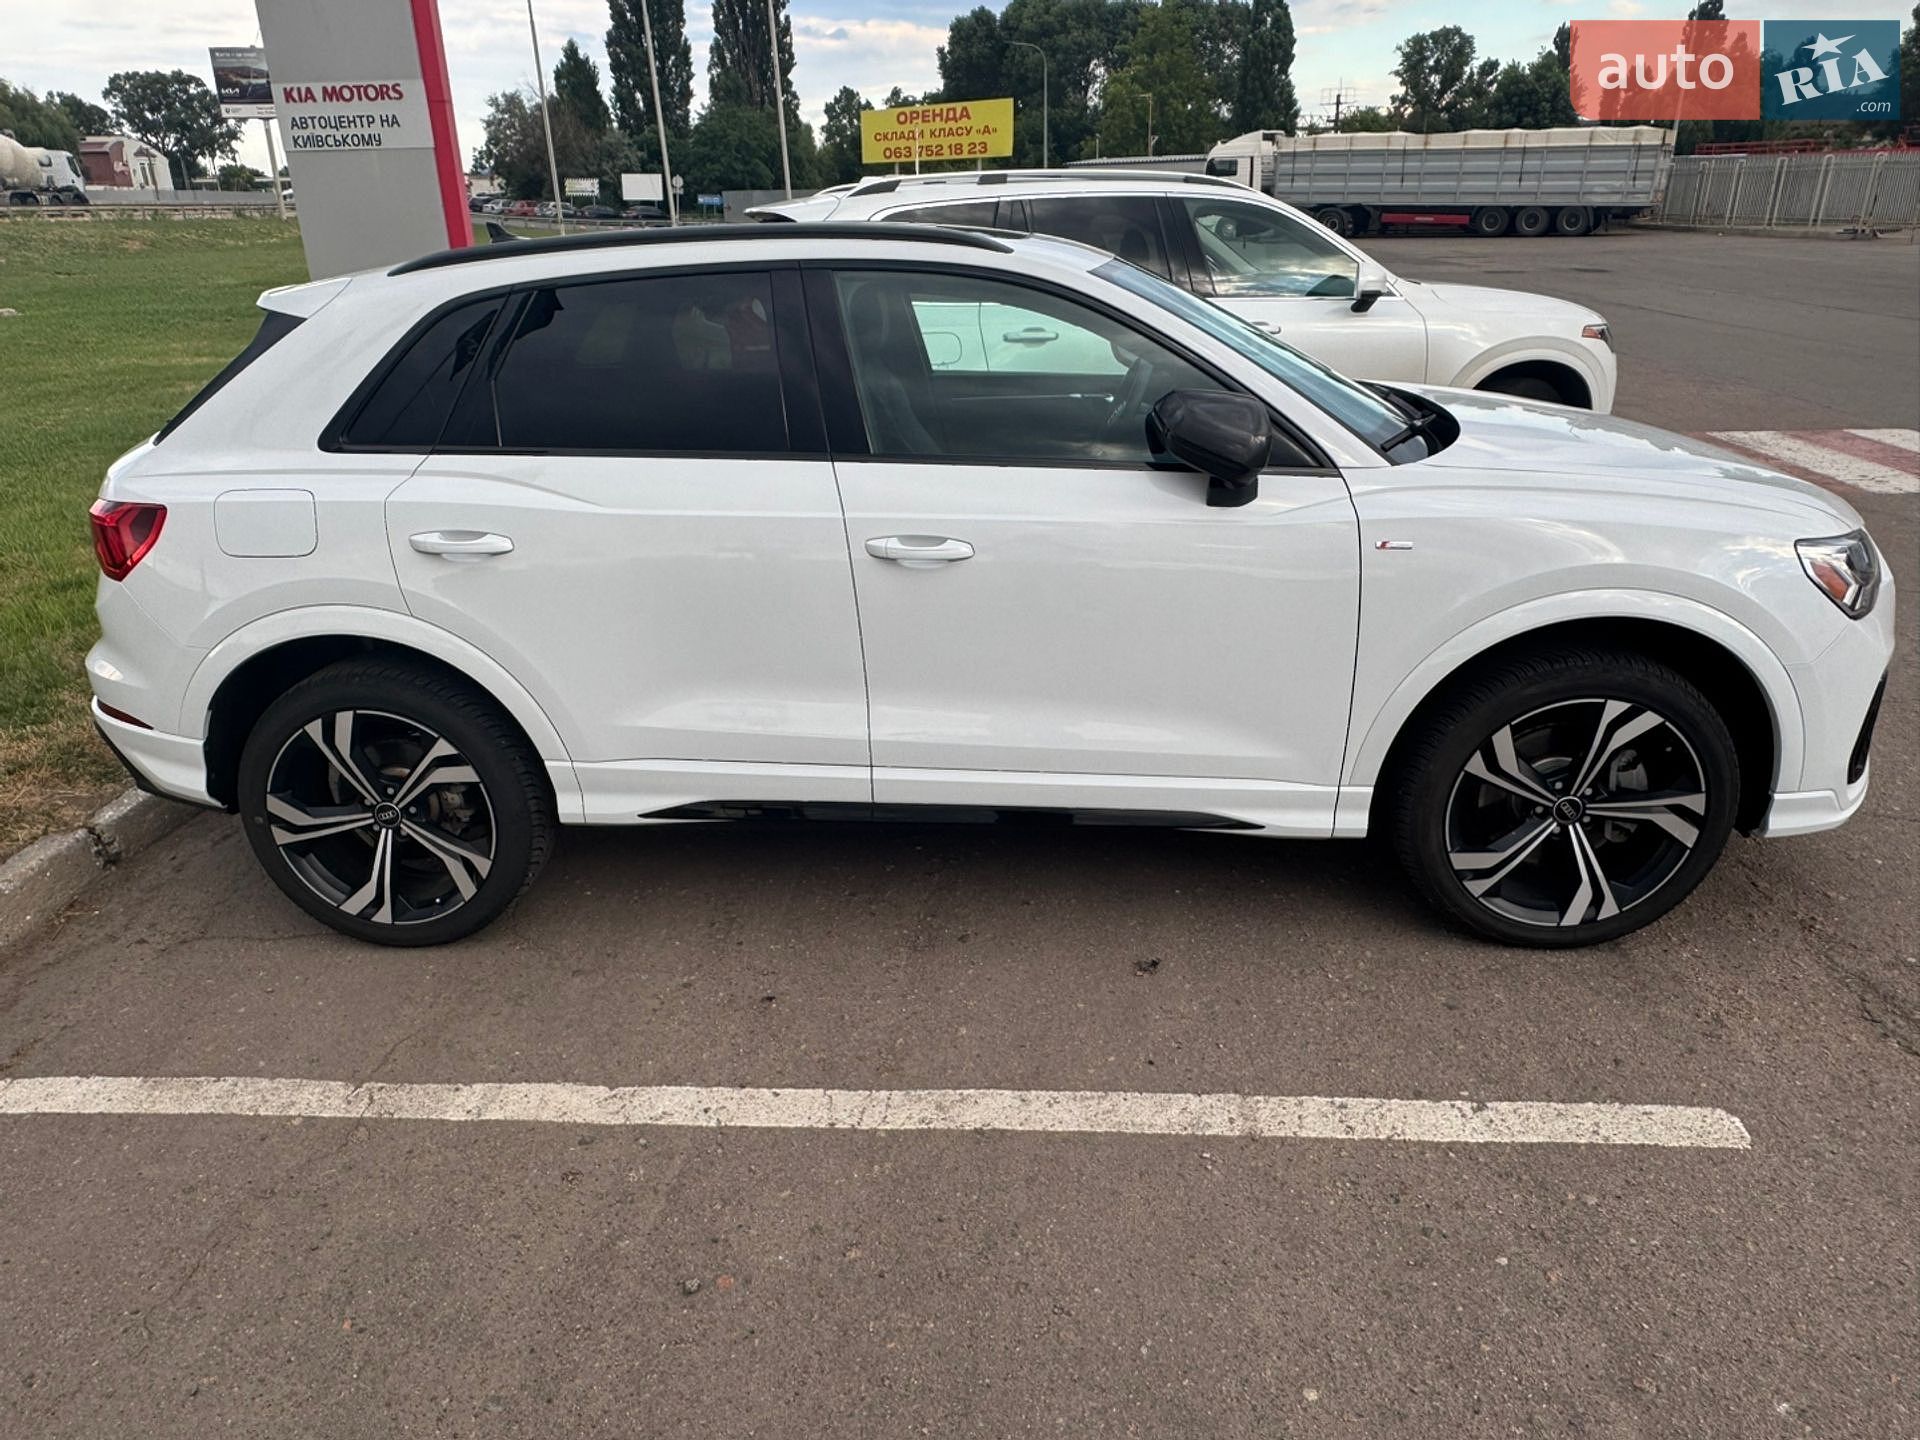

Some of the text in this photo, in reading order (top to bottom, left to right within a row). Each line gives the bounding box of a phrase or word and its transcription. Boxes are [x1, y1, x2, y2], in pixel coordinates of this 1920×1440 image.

[282, 83, 404, 103] KIA MOTORS
[290, 114, 401, 131] АВТОЦЕНТР НА
[896, 106, 971, 125] ОРЕНДА
[292, 133, 382, 149] КИЇВСЬКОМУ
[930, 126, 973, 139] КЛАСУ
[883, 141, 988, 160] 063 752 18 23
